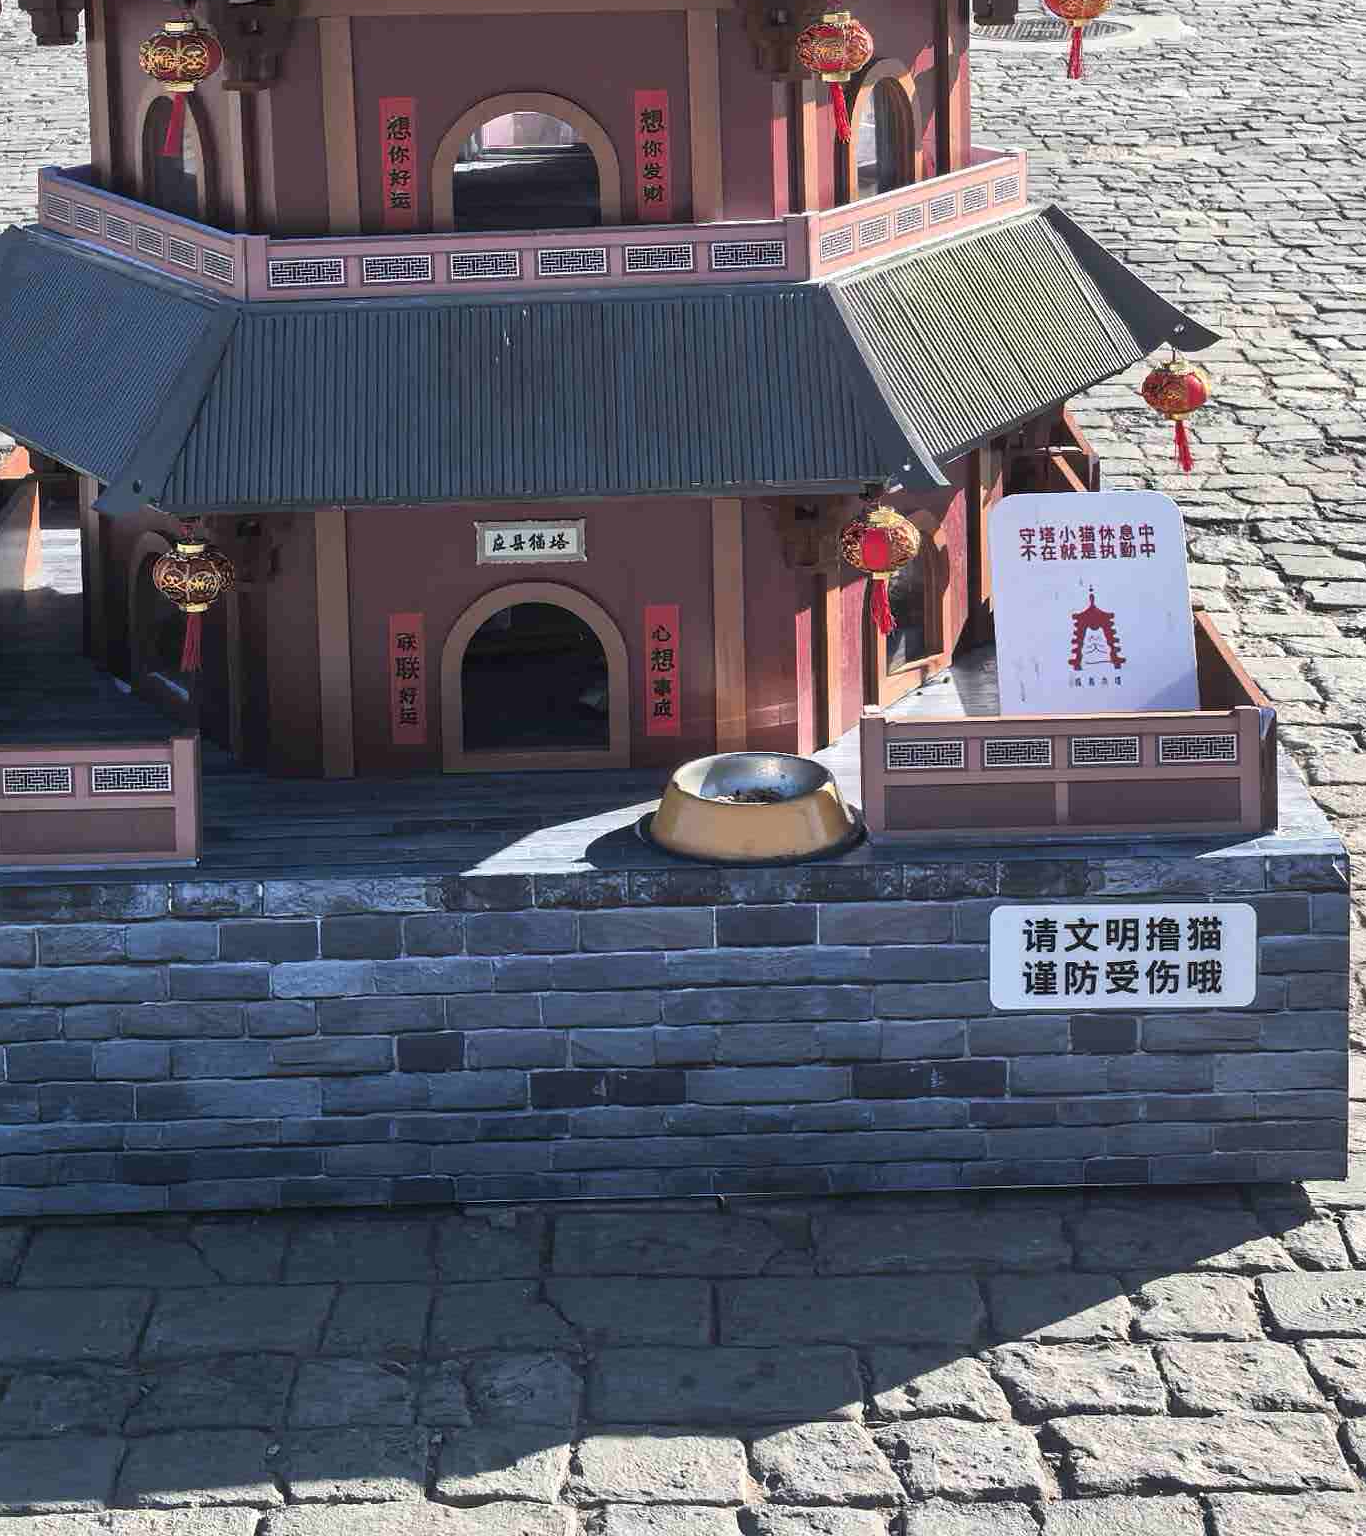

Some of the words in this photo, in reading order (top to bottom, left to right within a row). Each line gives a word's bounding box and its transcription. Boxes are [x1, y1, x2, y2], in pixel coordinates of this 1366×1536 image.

[386, 115, 412, 210] 想你好运
[639, 108, 665, 204] 想你发财
[1019, 524, 1155, 544] 守塔小猫休息中
[1020, 542, 1156, 561] 不在就是执勤中
[651, 624, 675, 719] 心想事成
[1022, 917, 1223, 953] 请文明撸猫
[1022, 960, 1223, 996] 谨防受伤哦
